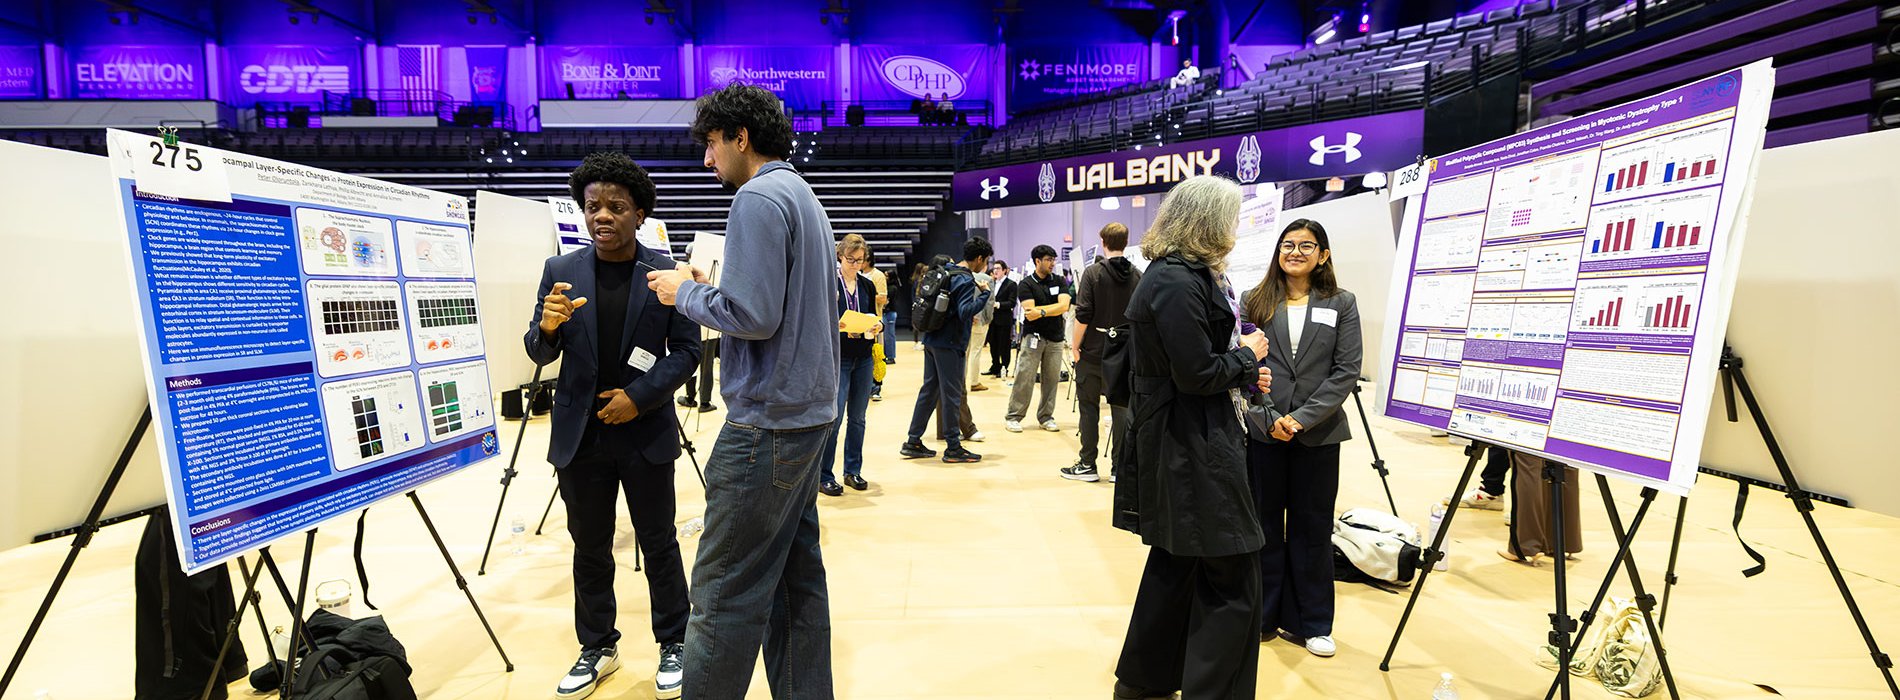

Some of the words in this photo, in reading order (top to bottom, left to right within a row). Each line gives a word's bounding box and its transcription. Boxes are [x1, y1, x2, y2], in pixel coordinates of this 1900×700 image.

[77, 63, 193, 82] ELEVATION
[239, 64, 350, 94] CDTA
[562, 63, 600, 78] BONE
[603, 63, 618, 78] &
[623, 63, 661, 78] JOINT
[740, 68, 825, 79] Northwestern
[894, 64, 952, 89] CDPHP
[1044, 64, 1136, 75] FENIMORE
[586, 81, 639, 90] CENTER
[1482, 145, 1506, 158] Compound
[1526, 133, 1551, 146] Synthesis
[1551, 130, 1561, 138] and
[1562, 123, 1590, 136] Screening
[1598, 113, 1626, 126] Myotonic
[1627, 103, 1660, 119] Dystrophy
[1660, 99, 1677, 110] Type
[150, 141, 202, 172] 275
[1066, 148, 1221, 193] UALBANY
[1400, 166, 1420, 186] 288
[255, 162, 305, 177] Layer-Specific
[306, 170, 330, 182] Changes
[337, 176, 356, 188] Protein
[356, 180, 384, 192] Expression
[390, 186, 410, 197] Circadian
[411, 190, 430, 200] Rhythms
[555, 201, 574, 214] 276
[169, 377, 202, 389] Methods
[191, 517, 231, 535] Conclusions
